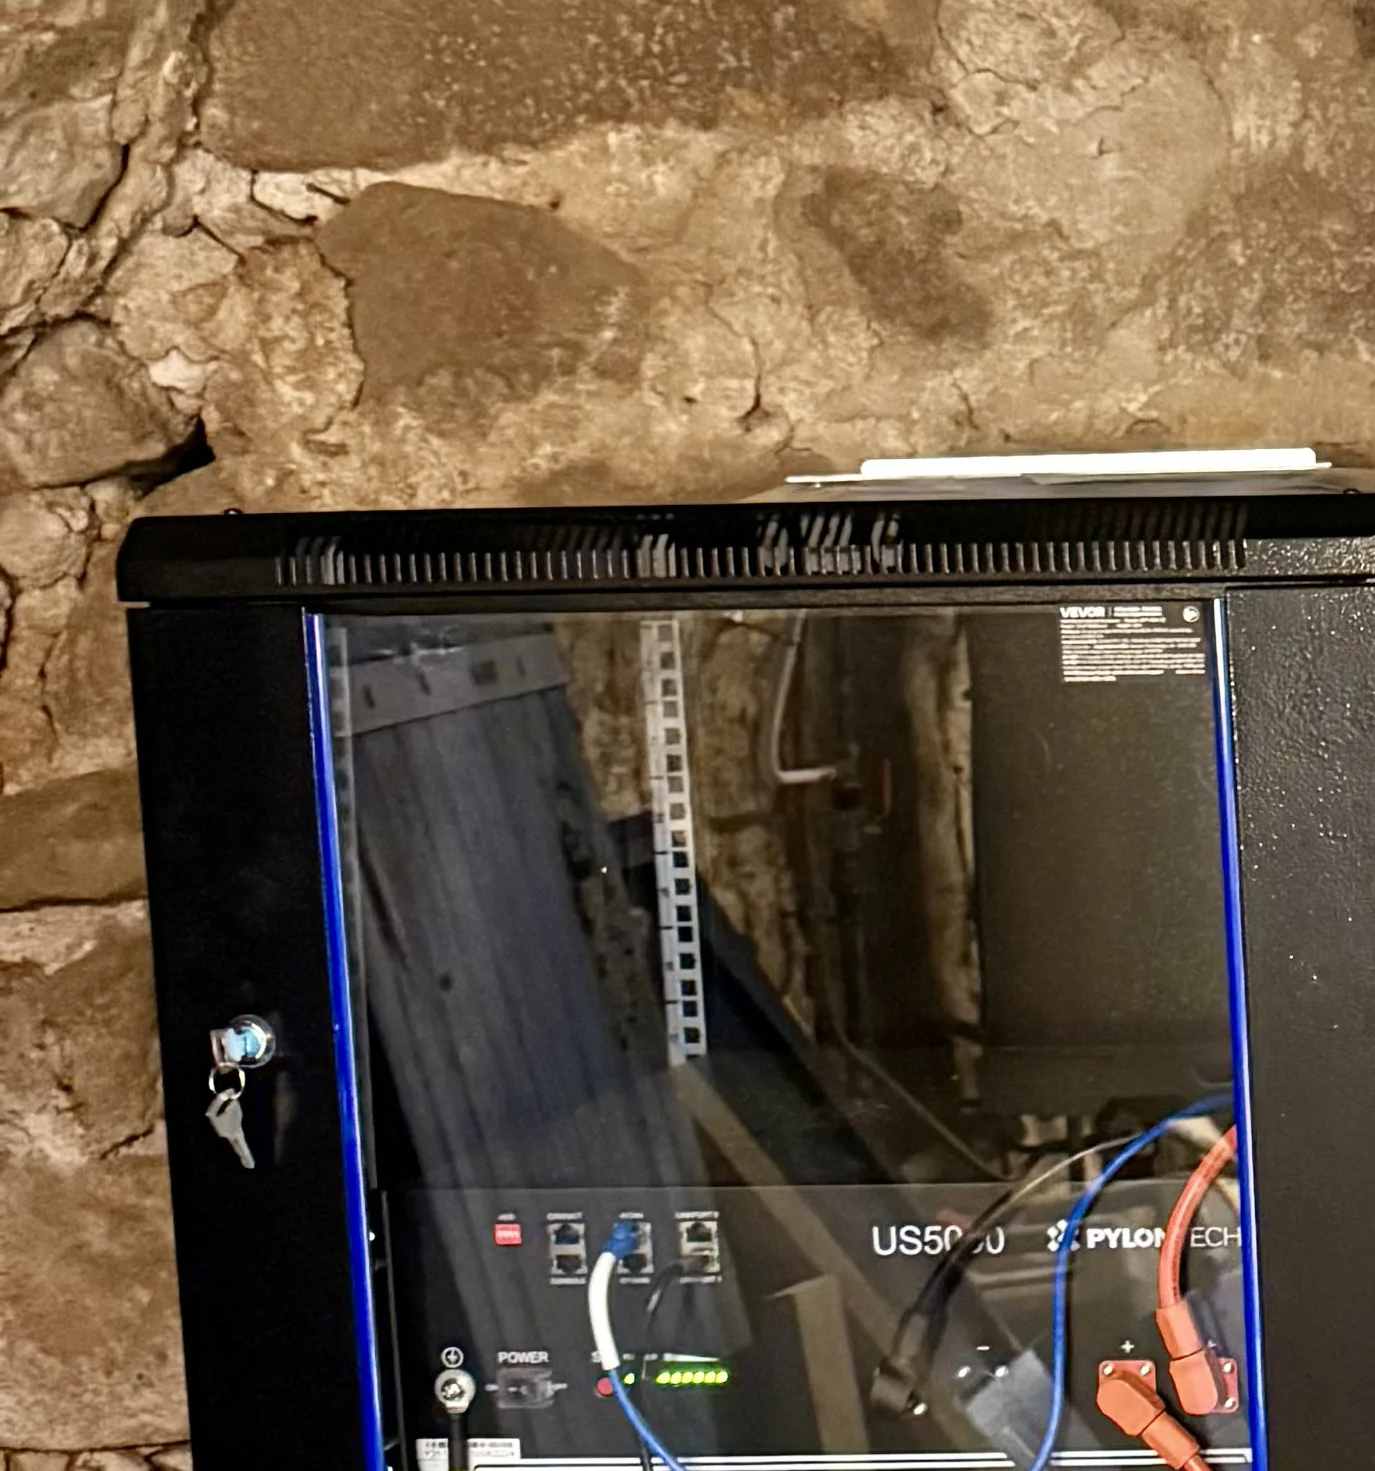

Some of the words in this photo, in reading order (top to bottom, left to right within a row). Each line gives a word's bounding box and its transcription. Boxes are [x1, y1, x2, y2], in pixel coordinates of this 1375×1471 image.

[872, 1224, 1005, 1257] US500
[1086, 1226, 1243, 1250] PYLONECH
[497, 1351, 549, 1364] POWER
